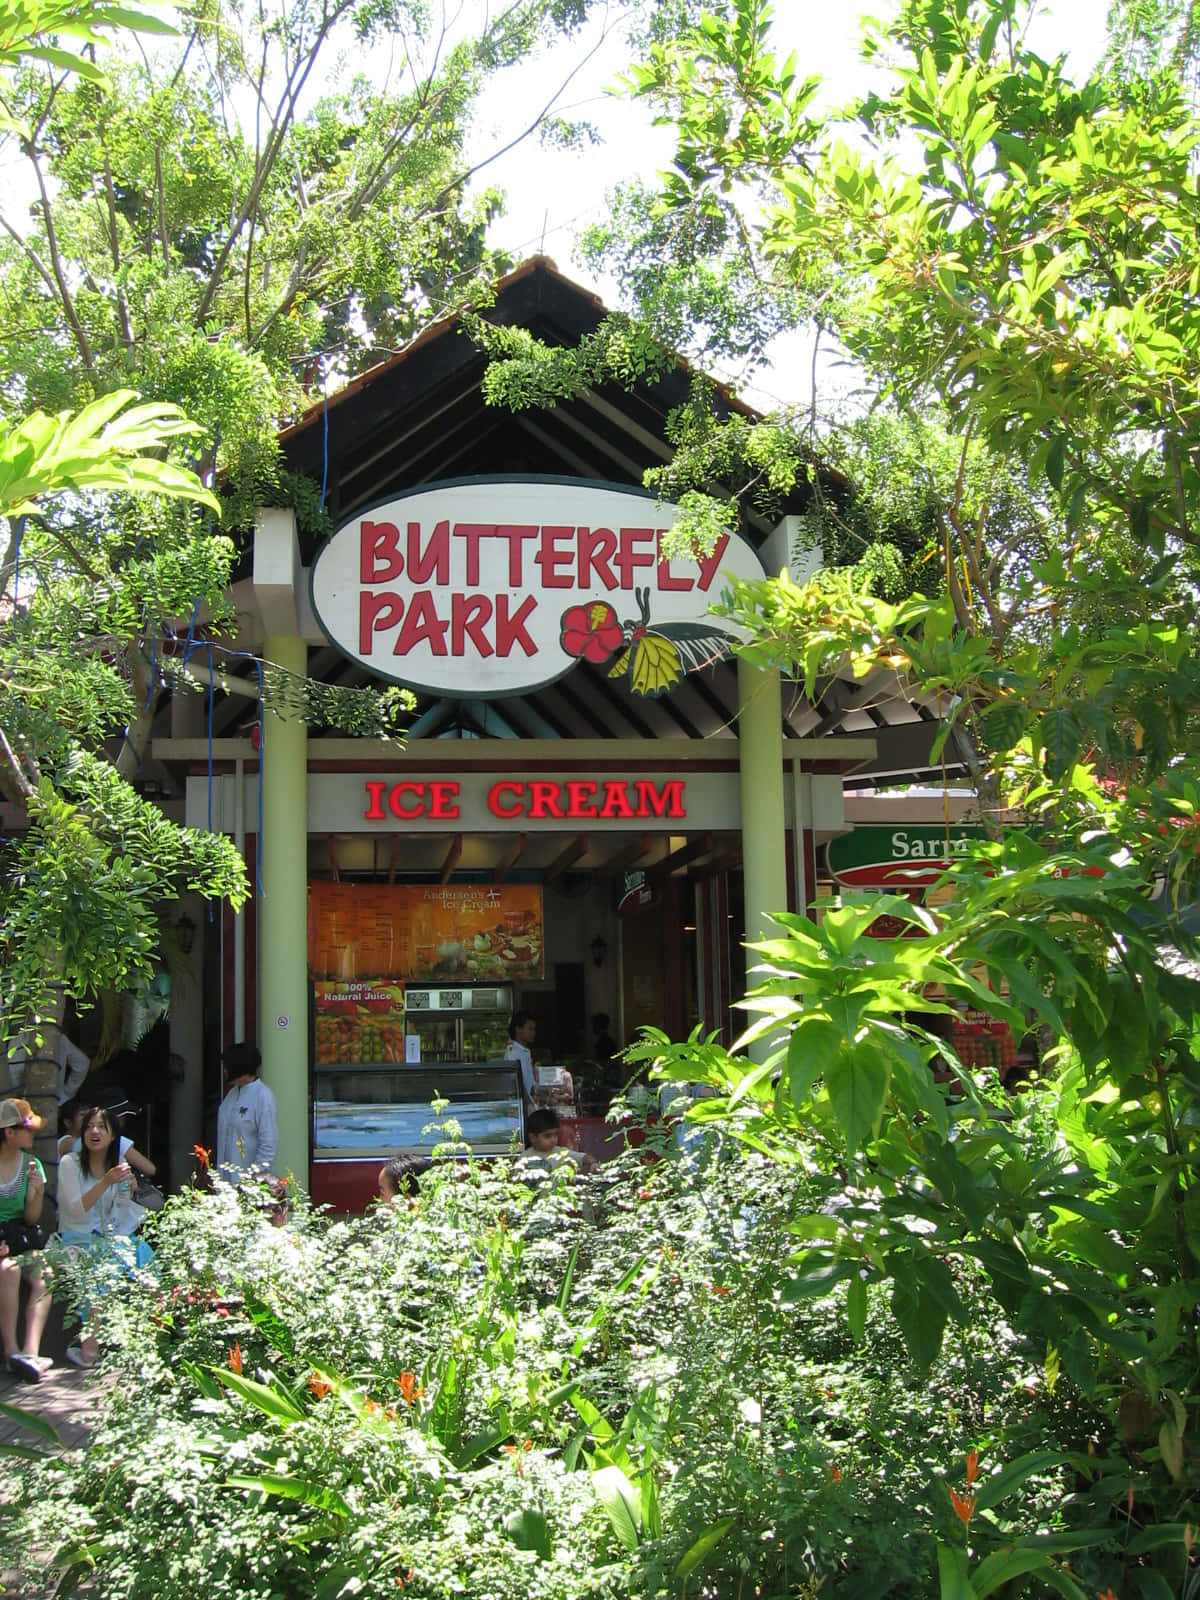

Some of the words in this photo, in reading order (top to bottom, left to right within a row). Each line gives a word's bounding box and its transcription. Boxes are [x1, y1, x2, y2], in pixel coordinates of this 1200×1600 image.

[359, 519, 731, 592] BUTTERFLY
[358, 590, 538, 658] PARK
[364, 780, 461, 820] ICE
[486, 780, 687, 819] CREAM
[323, 991, 362, 1001] Natural
[364, 991, 392, 1000] Juice
